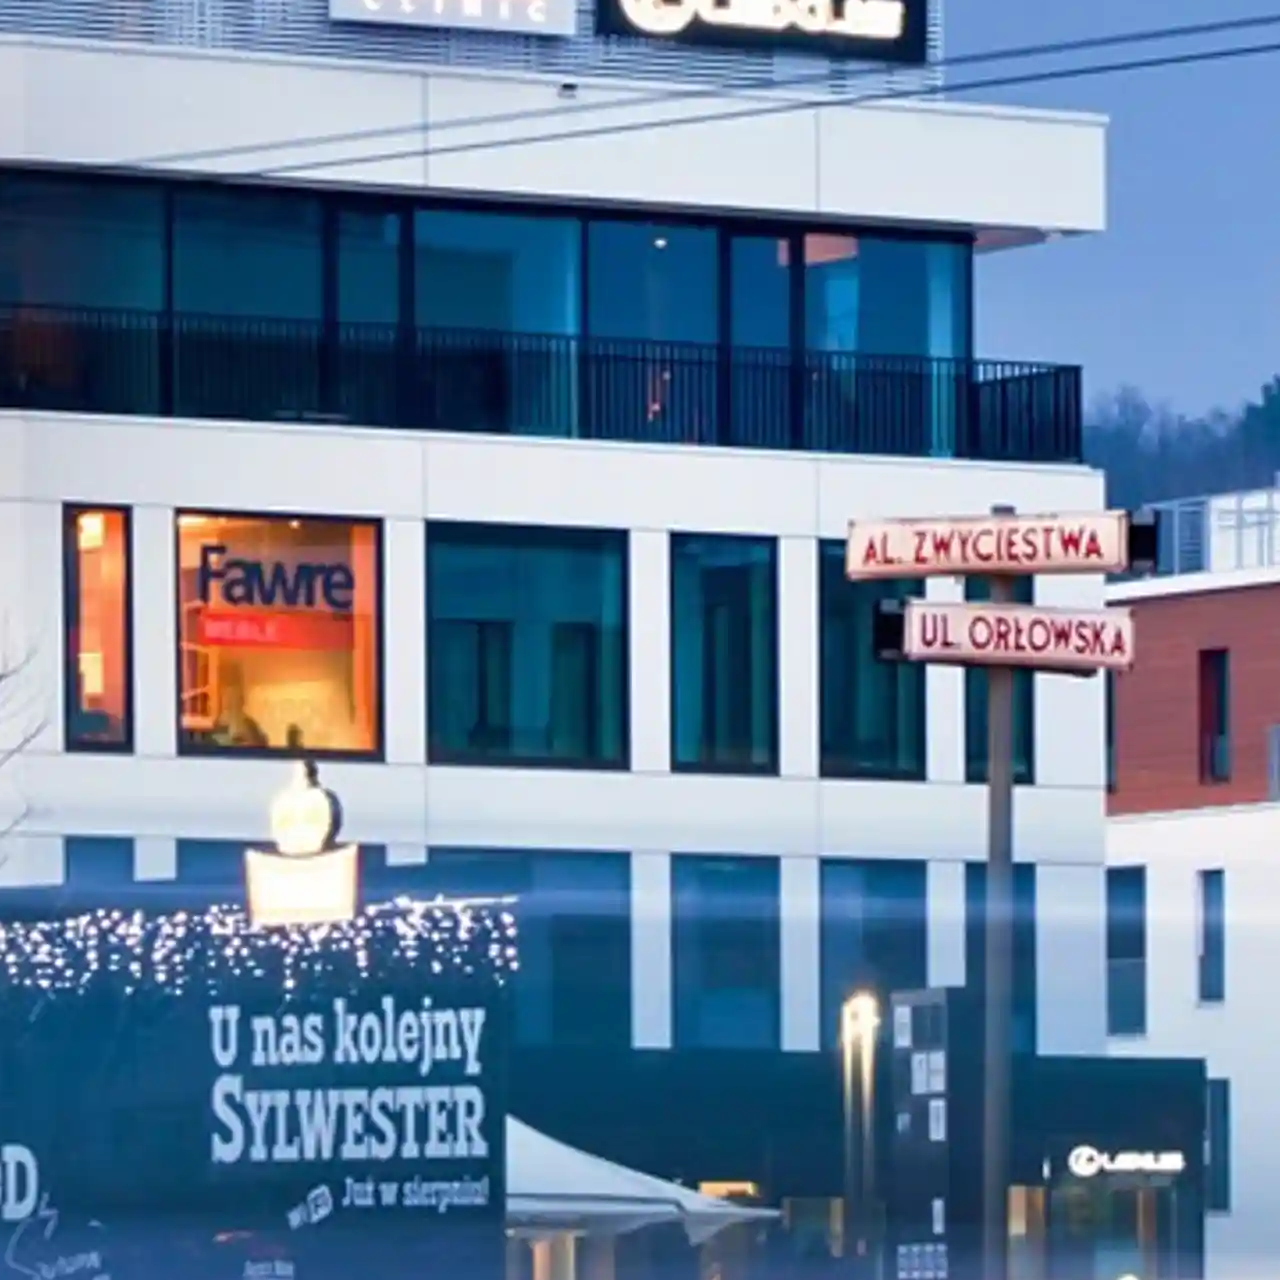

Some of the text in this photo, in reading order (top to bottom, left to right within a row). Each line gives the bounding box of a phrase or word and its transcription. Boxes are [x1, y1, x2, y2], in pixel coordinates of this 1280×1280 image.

[198, 544, 355, 608] Fawre
[862, 531, 903, 566] AL.
[968, 615, 1127, 656] ORŁOWSKA
[209, 995, 486, 1076] U nas kolejny
[211, 1074, 490, 1163] SYLWESTER
